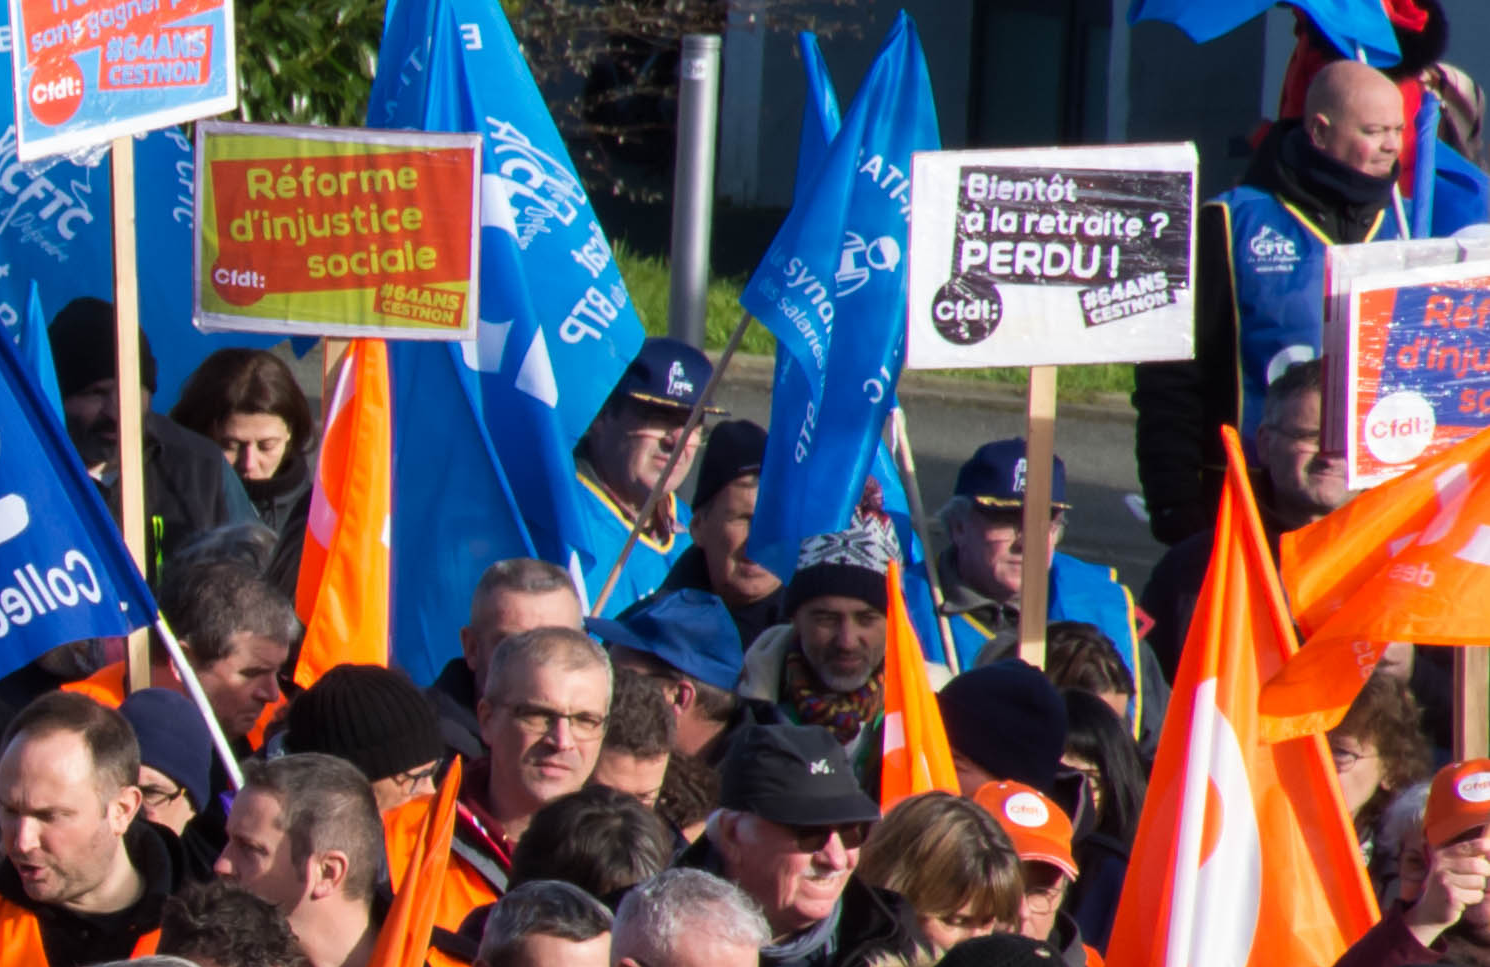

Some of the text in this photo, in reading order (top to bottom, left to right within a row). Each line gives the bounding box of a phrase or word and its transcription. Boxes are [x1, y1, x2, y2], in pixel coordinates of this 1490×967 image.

[31, 18, 84, 53] sans
[106, 27, 207, 63] #64ANS
[32, 76, 81, 105] Cfdt:
[108, 60, 202, 86] CESTNON
[246, 163, 419, 201] Réforme
[966, 172, 1079, 203] Bientôt
[0, 161, 94, 241] CFTC
[229, 203, 424, 247] d'injustice
[964, 203, 1170, 239] à la retraite ?
[307, 240, 438, 279] sociale
[960, 240, 1121, 280] PERDU !
[214, 267, 267, 289] Cfdt:
[1082, 271, 1170, 311] #64ANS
[379, 283, 461, 311] #64ANS
[381, 302, 456, 324] CESTNON
[935, 299, 999, 322] Cfdt:
[1087, 289, 1170, 325] CESTNON
[1371, 417, 1430, 440] Cfdt:
